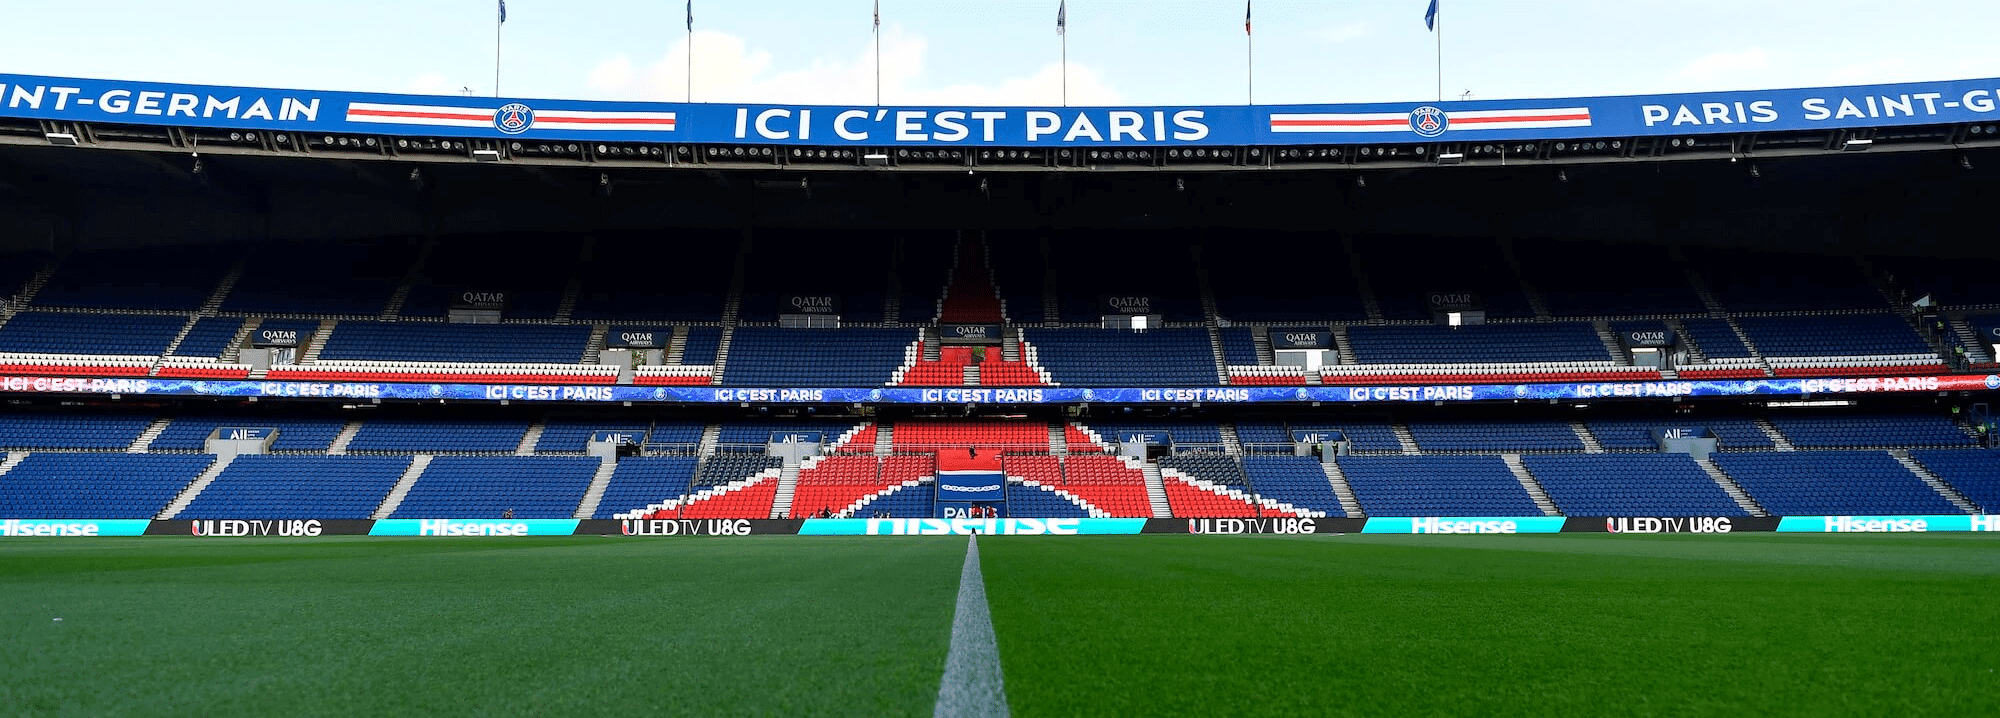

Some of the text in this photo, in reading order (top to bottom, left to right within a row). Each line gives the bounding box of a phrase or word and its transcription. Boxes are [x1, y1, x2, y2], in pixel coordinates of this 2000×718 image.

[1642, 88, 2000, 127] PARIS SAINT-G
[734, 108, 1209, 141] ICI C'EST PARIS
[463, 292, 503, 303] QATAR
[791, 296, 832, 308] QATAR
[1110, 297, 1149, 308] QATAR
[1431, 294, 1470, 305] QATAR
[263, 330, 296, 340] QATAR
[621, 332, 652, 342] QATAR
[956, 326, 985, 335] QATAR
[1632, 332, 1664, 341] QATAR
[1286, 333, 1316, 342] QATAR
[486, 385, 612, 400] ICI C'EST PARIS
[715, 389, 822, 401] ICI C'EST PARIS
[922, 389, 1042, 402] ICI C'EST PARIS
[1142, 389, 1248, 401] ICI C'EST PARIS
[1350, 386, 1473, 400] ICI C'EST PARIS
[279, 520, 322, 536] U8G
[420, 519, 529, 536] Hisense
[708, 519, 752, 535] U8G
[1273, 518, 1316, 534] U8G
[1411, 517, 1516, 534] Hisense
[1689, 517, 1732, 533] U8G
[1825, 516, 1928, 532] Hisense
